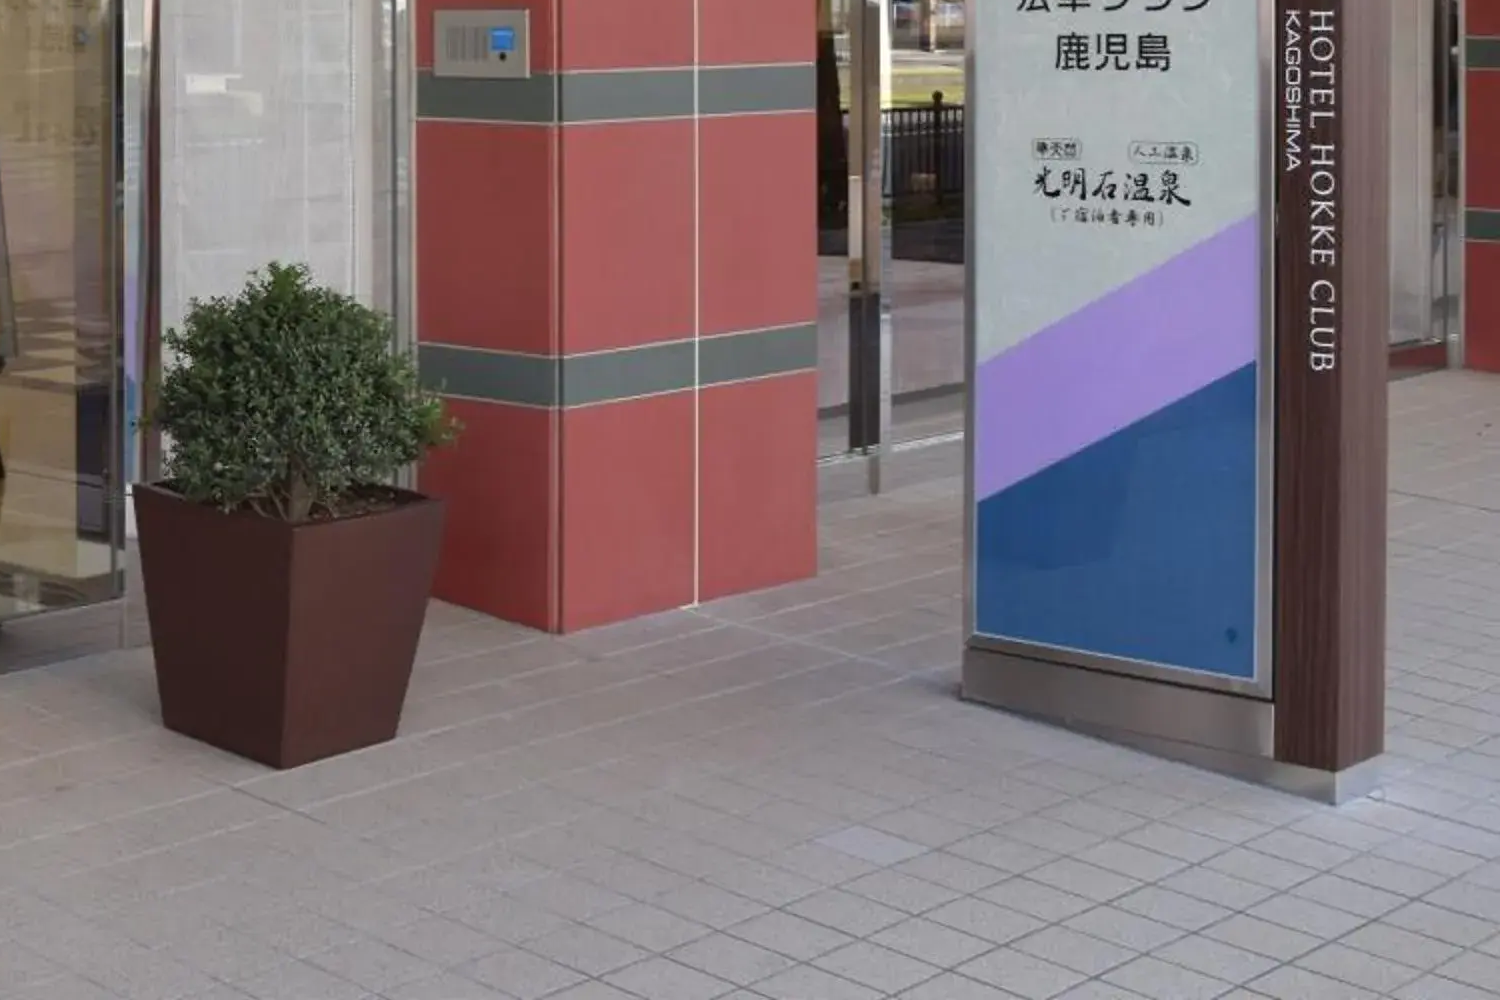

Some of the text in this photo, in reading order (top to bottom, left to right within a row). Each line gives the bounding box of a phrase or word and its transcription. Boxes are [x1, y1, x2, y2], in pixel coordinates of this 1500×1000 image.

[1055, 31, 1172, 72] 鹿児島
[1285, 9, 1302, 172] KAGOSHIMA
[1032, 165, 1192, 206] 光明石温泉
[1308, 10, 1336, 373] HOTEL HOKKE CLUB
